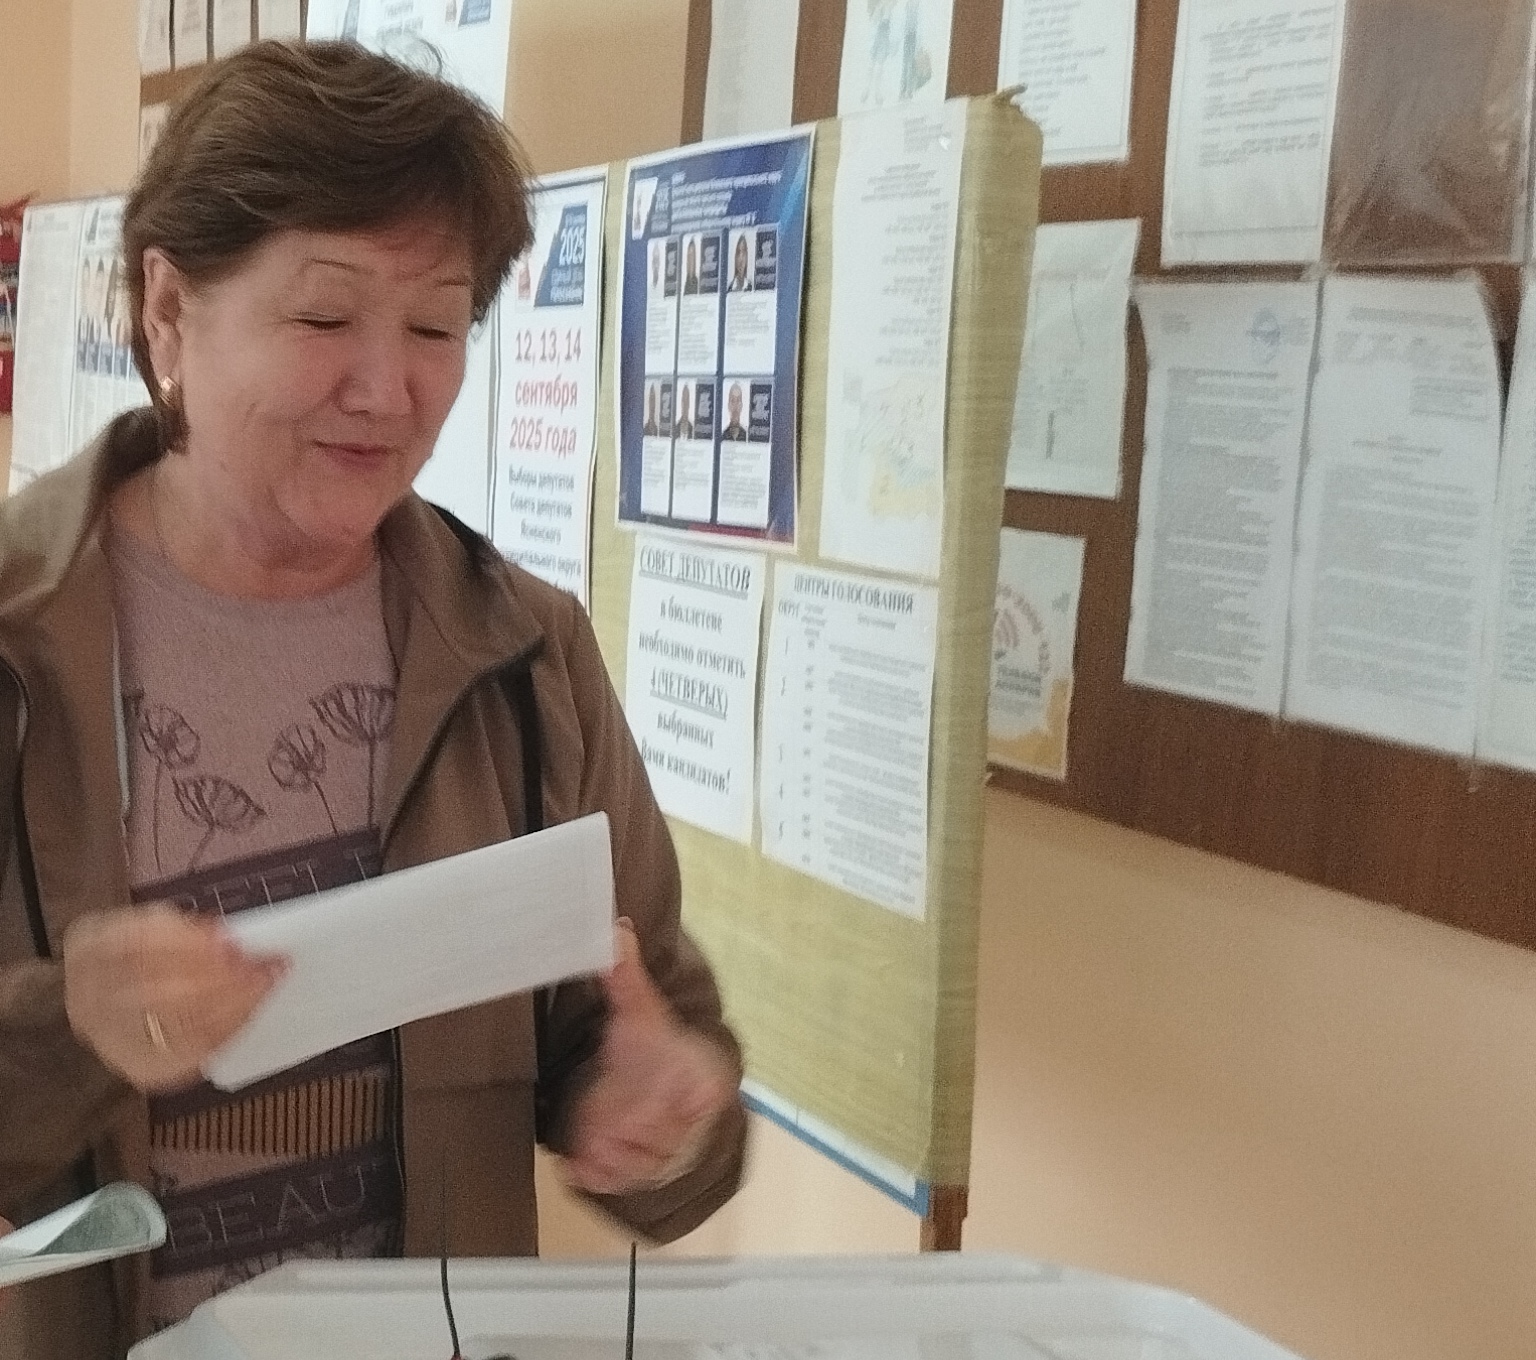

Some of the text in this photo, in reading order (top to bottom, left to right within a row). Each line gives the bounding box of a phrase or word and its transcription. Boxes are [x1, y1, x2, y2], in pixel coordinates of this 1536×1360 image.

[559, 226, 585, 266] 2025
[515, 326, 582, 369] 12, 13, 14
[514, 374, 578, 415] сентября
[509, 417, 577, 459] 2025 года
[640, 545, 751, 592] СОВЕТ ДЕПУТАТОВ
[831, 578, 914, 614] ГОЛОСОВАНИЯ
[639, 629, 746, 679] необходимо отметить
